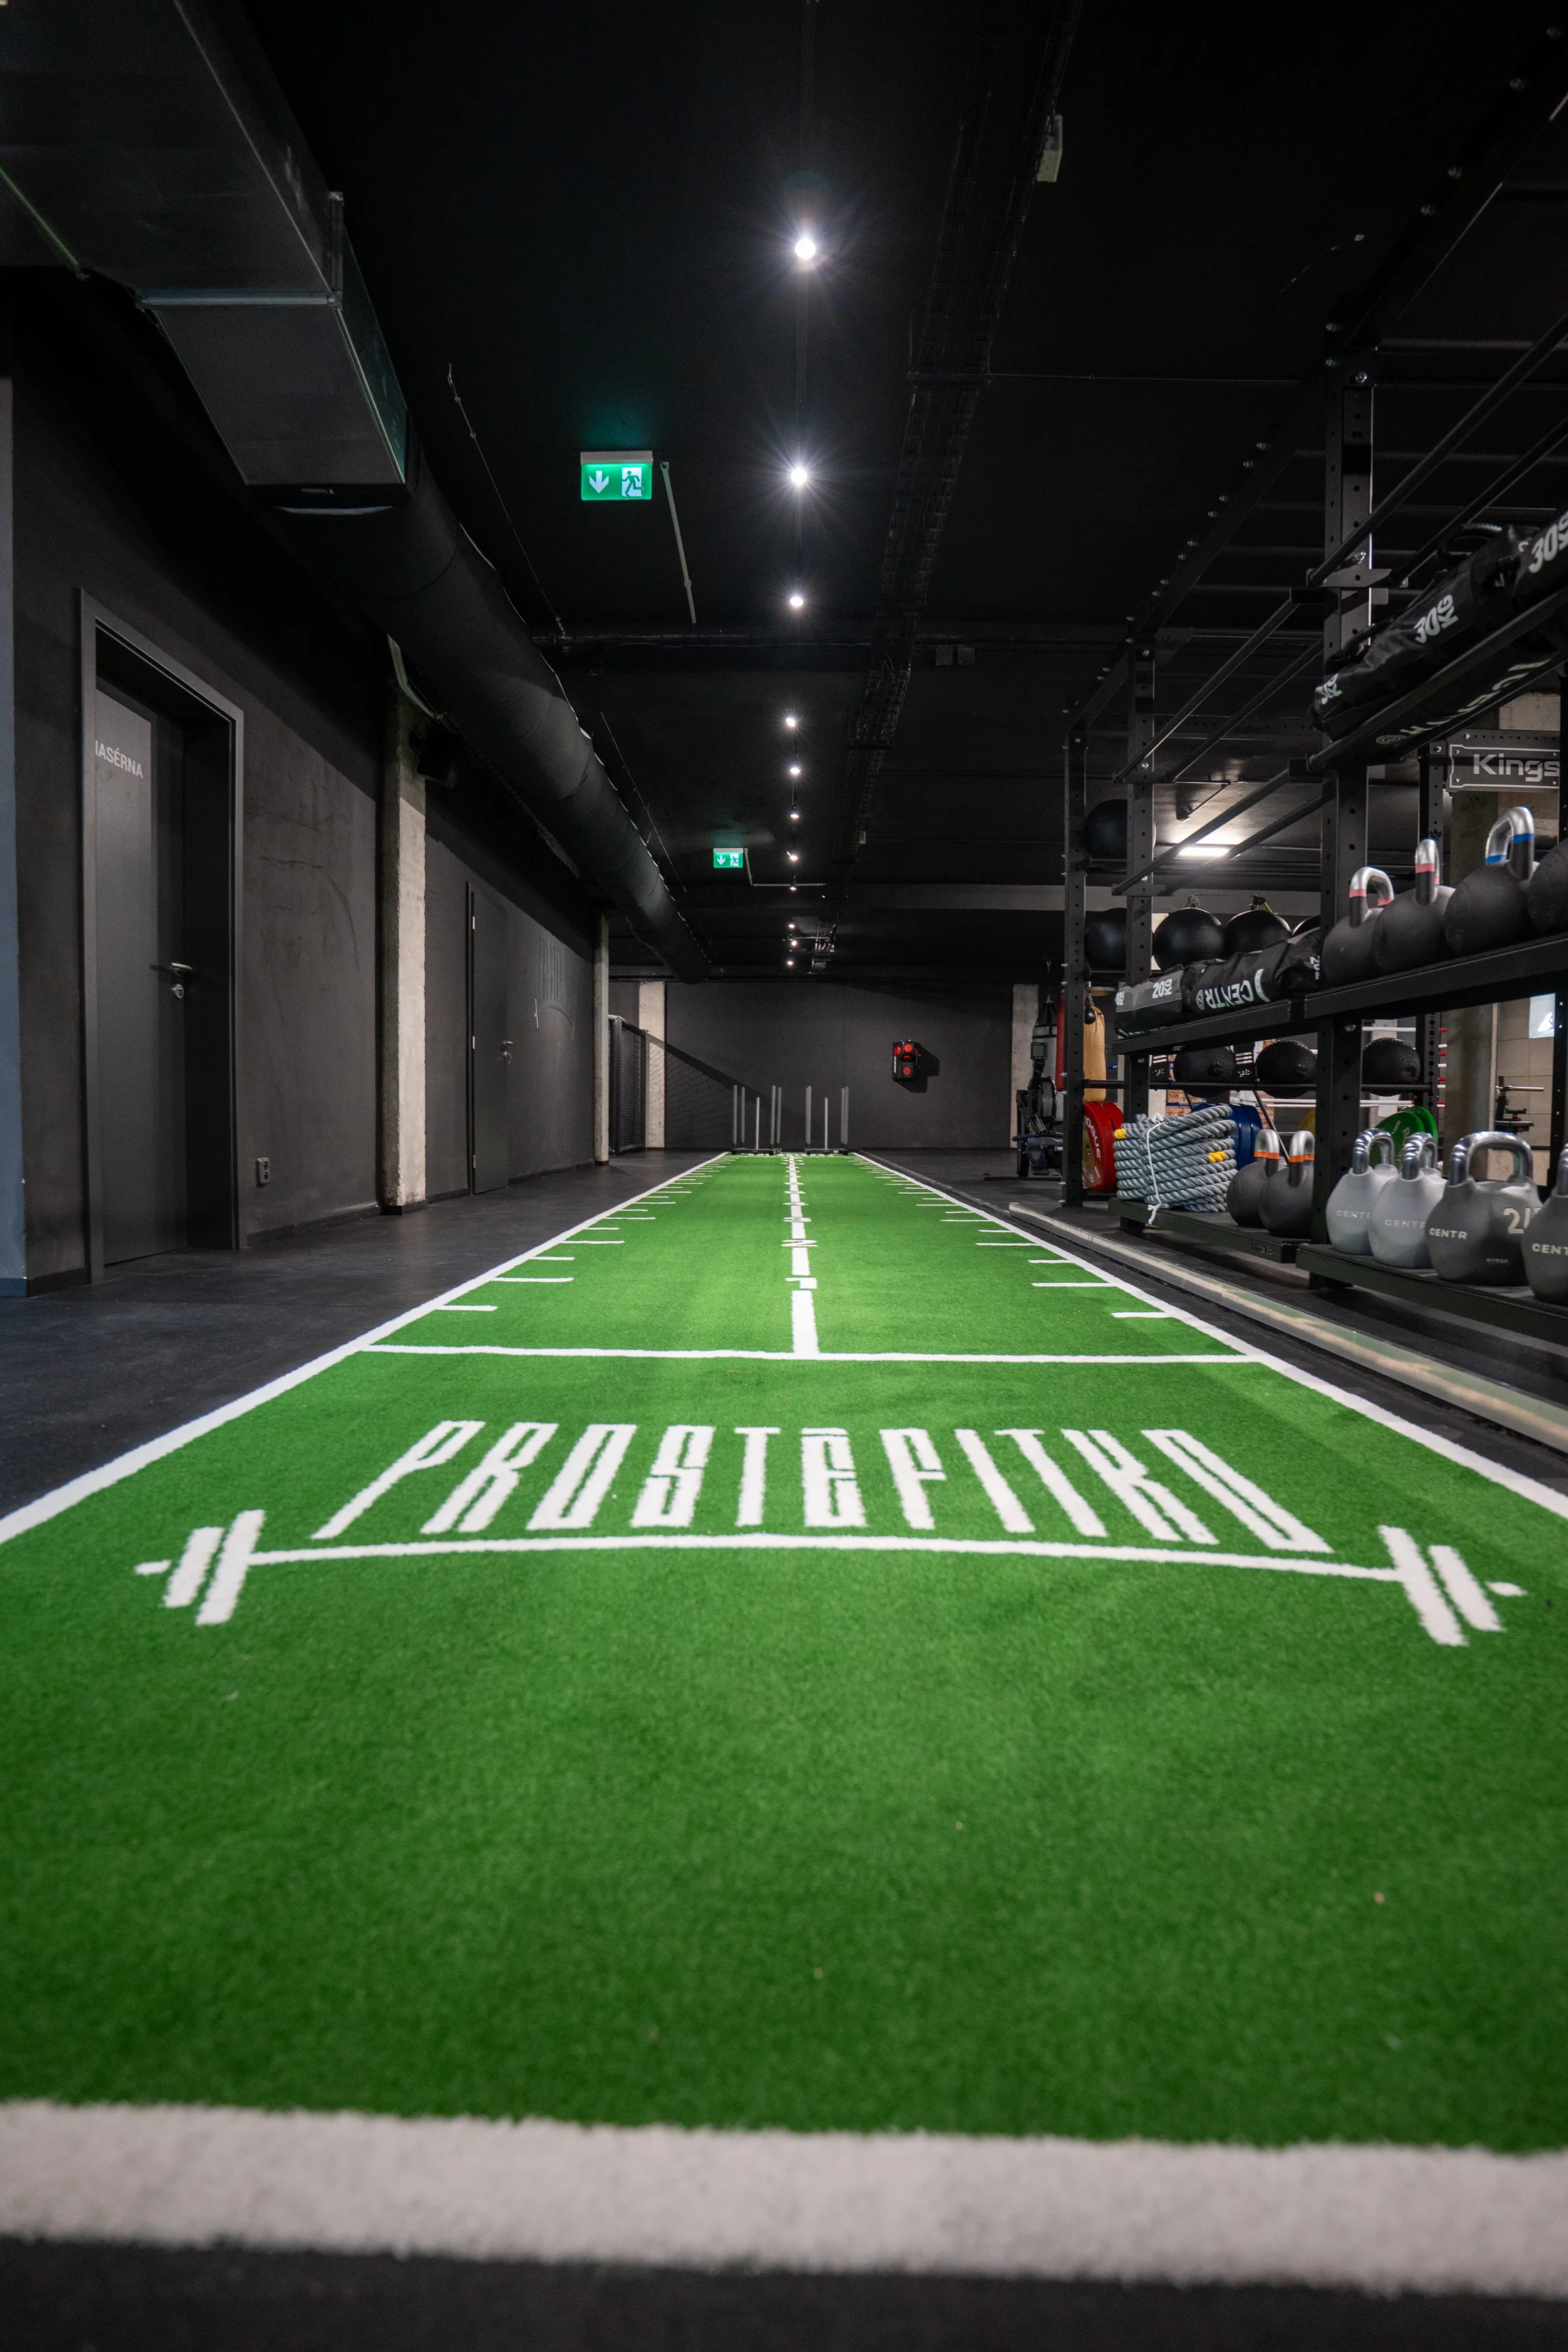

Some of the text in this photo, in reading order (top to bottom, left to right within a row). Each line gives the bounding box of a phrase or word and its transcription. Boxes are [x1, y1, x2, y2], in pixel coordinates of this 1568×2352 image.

[95, 740, 144, 779] ASÉRNA
[1473, 753, 1560, 783] Kings
[1429, 1227, 1468, 1239] CENTR
